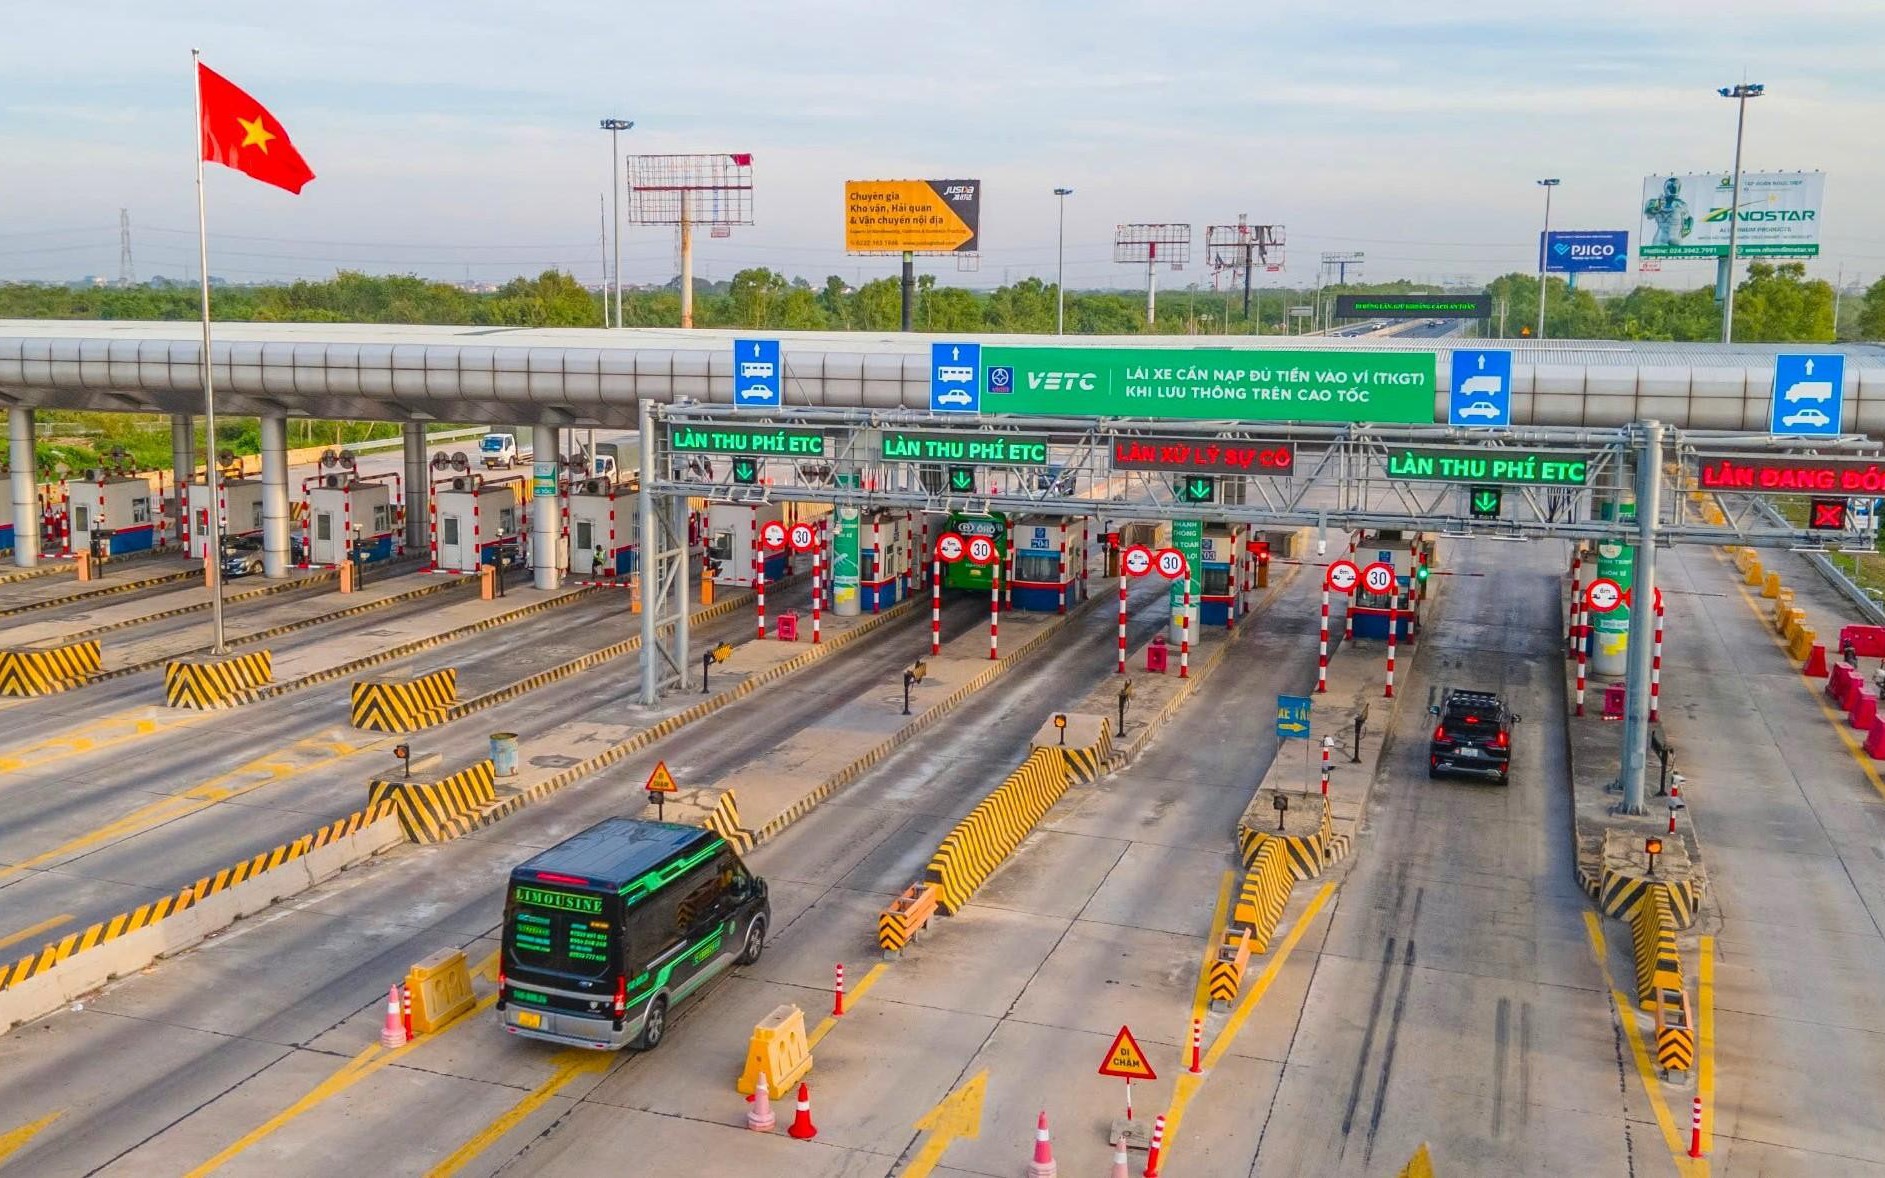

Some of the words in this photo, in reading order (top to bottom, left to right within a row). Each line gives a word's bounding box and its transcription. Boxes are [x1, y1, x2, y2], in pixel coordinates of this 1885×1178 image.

[886, 192, 900, 202] gia
[850, 204, 867, 213] Kho
[891, 203, 907, 212] Hải
[908, 204, 932, 214] quan
[850, 216, 857, 225] &
[929, 215, 944, 227] địa
[1571, 244, 1615, 256] PJICO
[1028, 371, 1098, 391] VETC
[1126, 366, 1149, 380] LÁI
[1153, 368, 1172, 380] XE
[1213, 369, 1246, 385] NẠP
[1249, 367, 1271, 382] ĐỦ
[1315, 369, 1348, 384] VÀO
[1352, 369, 1369, 384] VÍ
[1373, 371, 1425, 387] (TKGT)
[1125, 385, 1152, 398] KHI
[1157, 385, 1187, 398] LƯU
[1191, 384, 1248, 400] THÔNG
[1252, 385, 1292, 401] TRÊN
[1297, 389, 1332, 401] CAO
[1336, 386, 1370, 402] TỐC
[674, 427, 708, 448] LÀN
[711, 433, 747, 450] THU
[752, 431, 785, 451] PHÍ
[789, 436, 822, 453] ETC
[885, 435, 920, 456] LÀN
[925, 441, 964, 458] THU
[969, 438, 1004, 459] PHÍ
[1009, 444, 1045, 461] ETC
[1224, 449, 1256, 469] SỰ
[1390, 452, 1433, 475] LÀN
[1439, 459, 1486, 477] THU
[1493, 456, 1535, 479] PHÍ
[1541, 462, 1585, 481] ETC
[795, 531, 808, 544] 30
[973, 543, 988, 557] 30
[1163, 556, 1179, 570] 30
[1370, 571, 1387, 586] 30
[516, 888, 603, 913] LIMOUSINE
